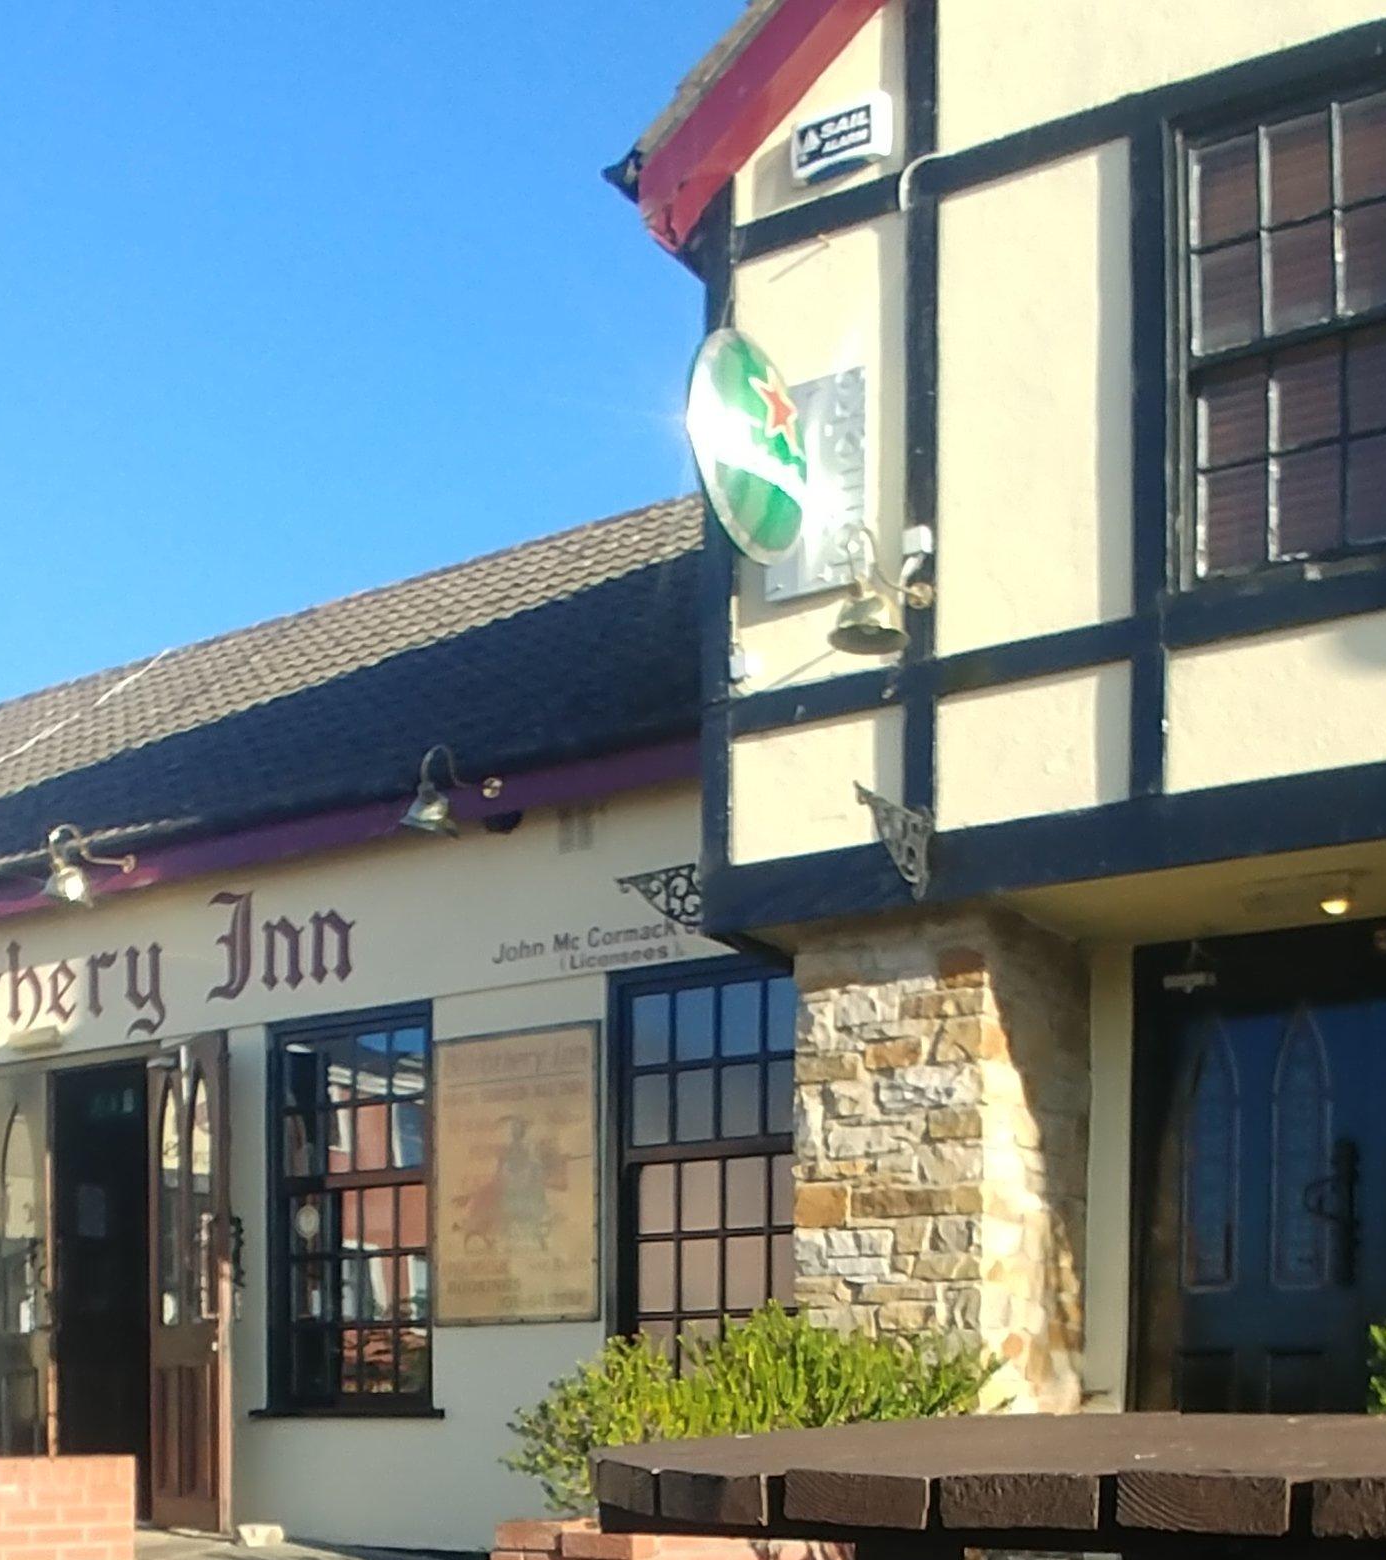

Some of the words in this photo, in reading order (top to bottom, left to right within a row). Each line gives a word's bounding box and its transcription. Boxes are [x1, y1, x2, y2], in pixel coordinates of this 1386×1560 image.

[206, 890, 356, 1003] Inn
[492, 940, 545, 965] John
[553, 932, 580, 953] Mc
[587, 919, 677, 948] Cormack
